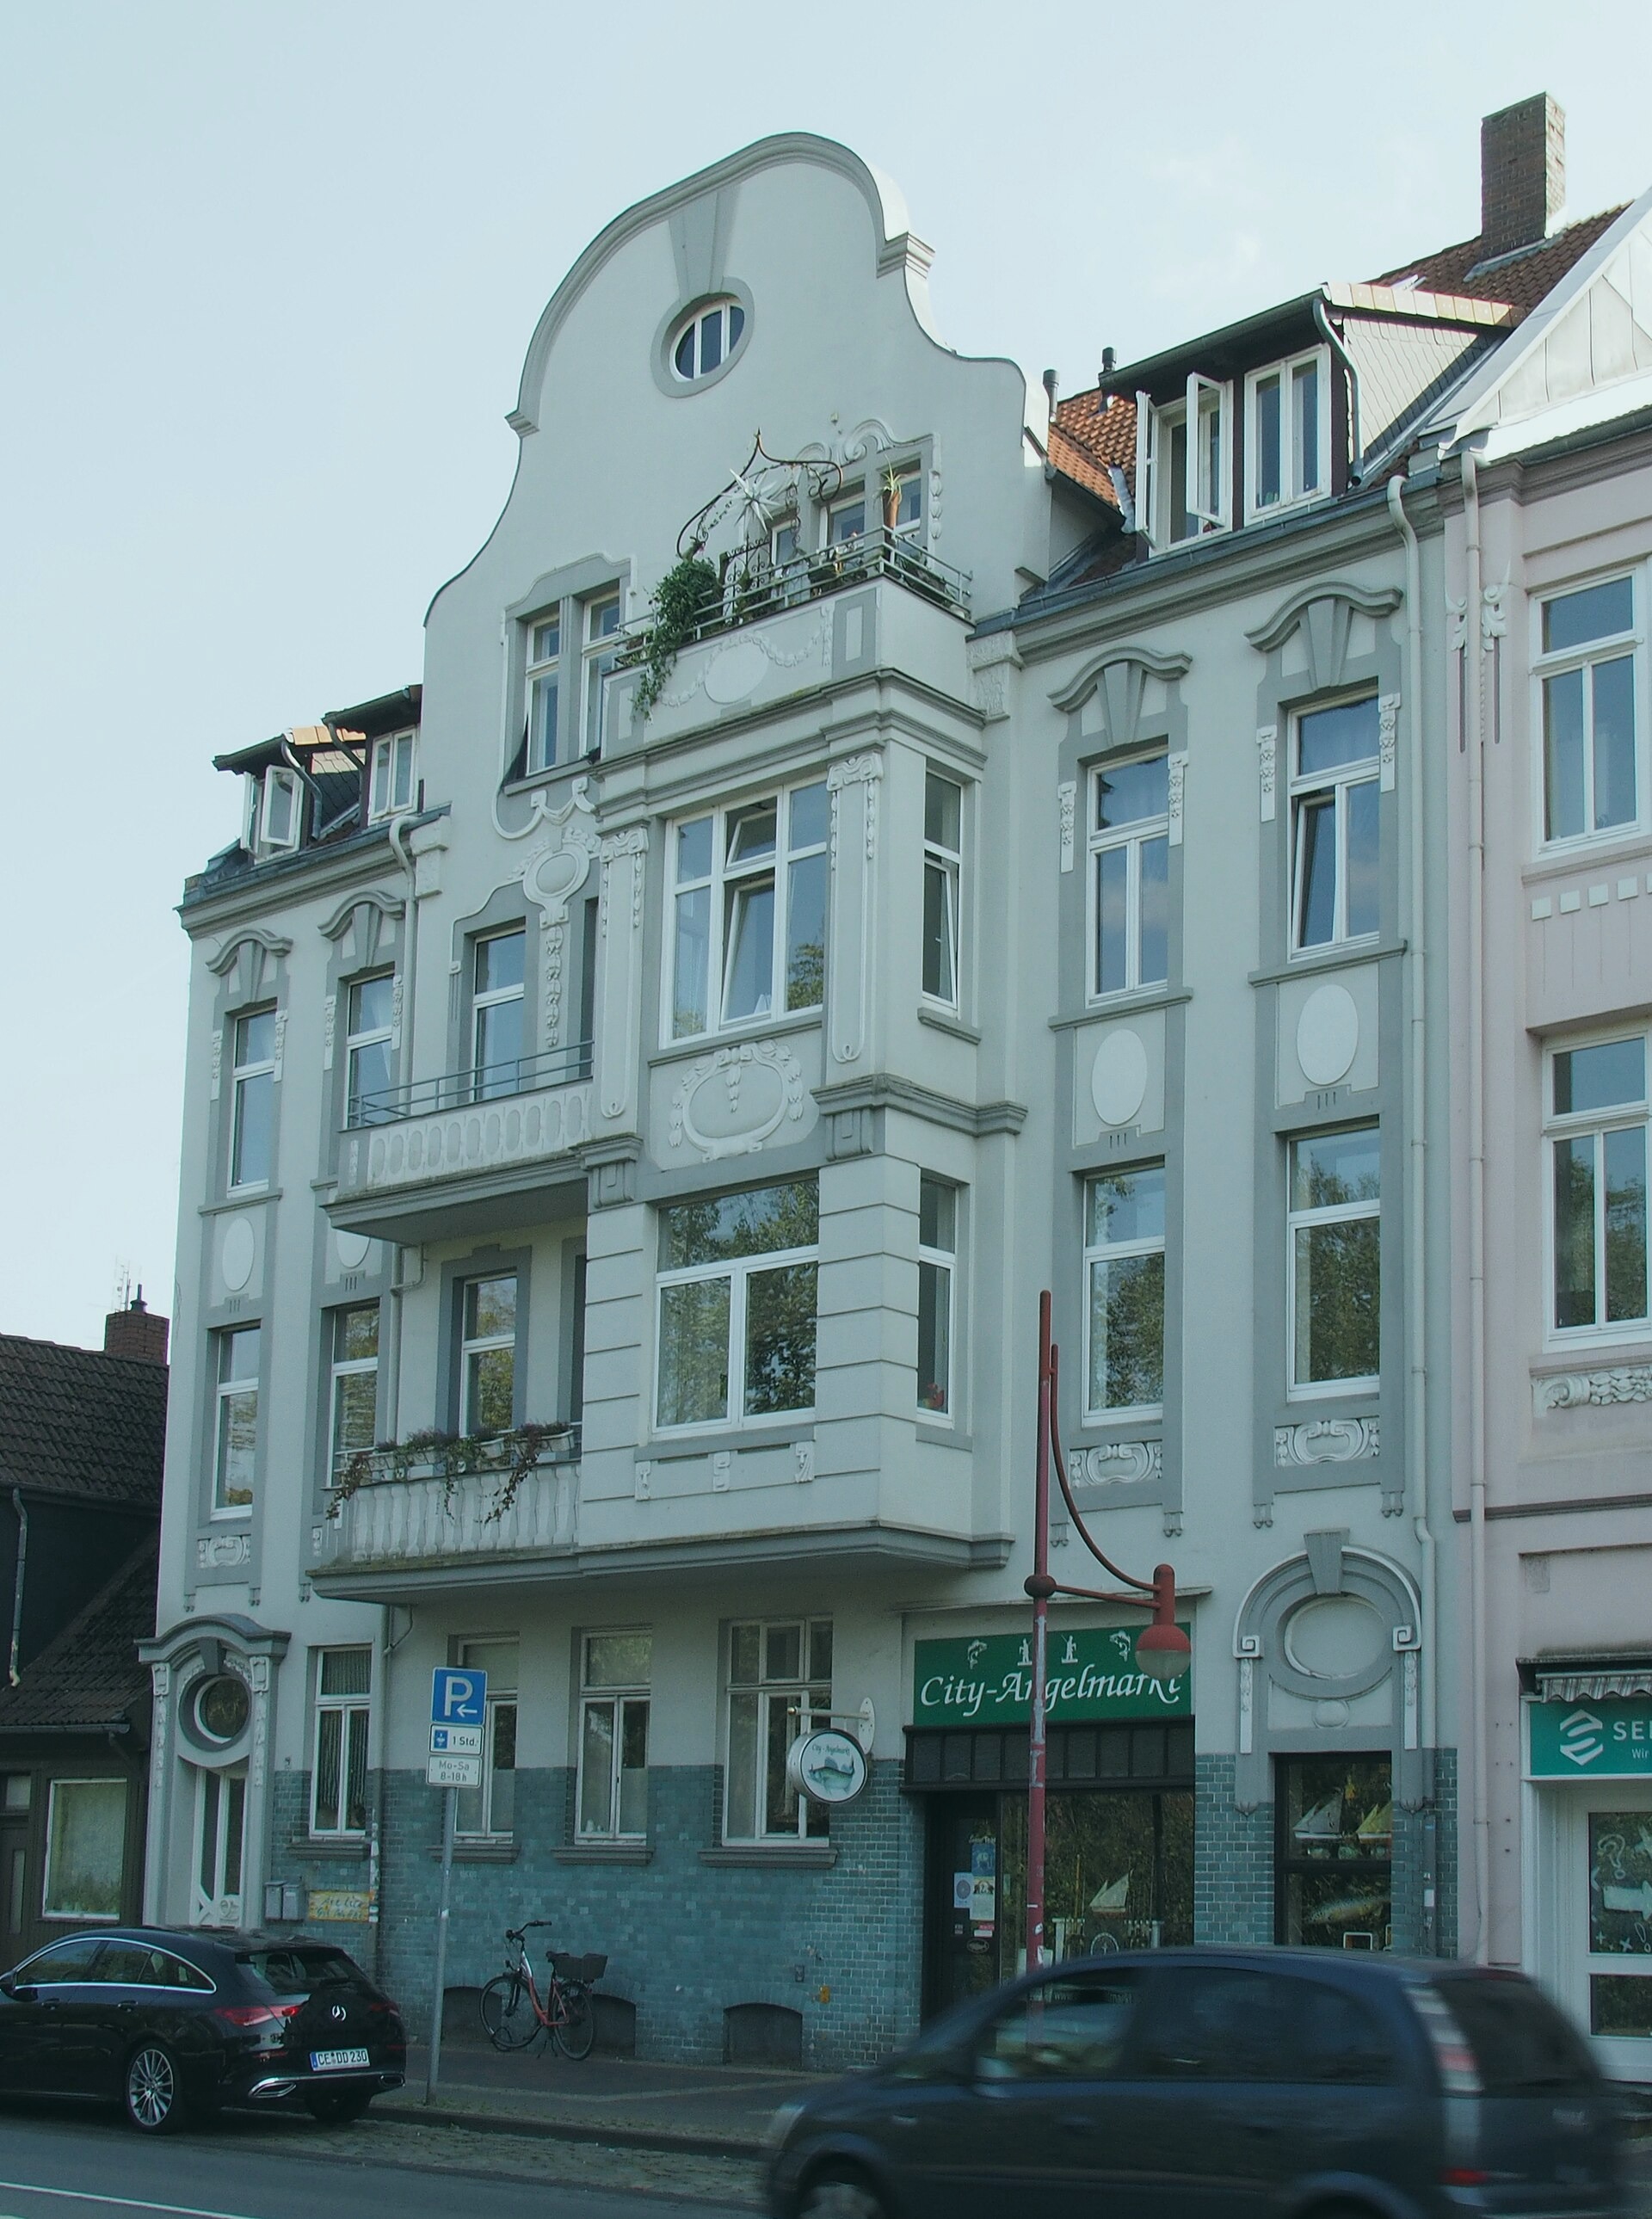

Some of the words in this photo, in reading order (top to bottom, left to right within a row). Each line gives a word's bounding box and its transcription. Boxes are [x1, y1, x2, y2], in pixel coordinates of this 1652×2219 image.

[444, 1675, 473, 1717] P
[1612, 1719, 1652, 1741] SE
[453, 1735, 456, 1745] 1
[459, 1735, 477, 1747] Std.
[1631, 1748, 1649, 1759] Wir
[439, 1760, 470, 1770] Mo-Sa
[317, 2053, 331, 2065] CE
[336, 2051, 349, 2063] DD
[349, 2049, 367, 2062] 230
